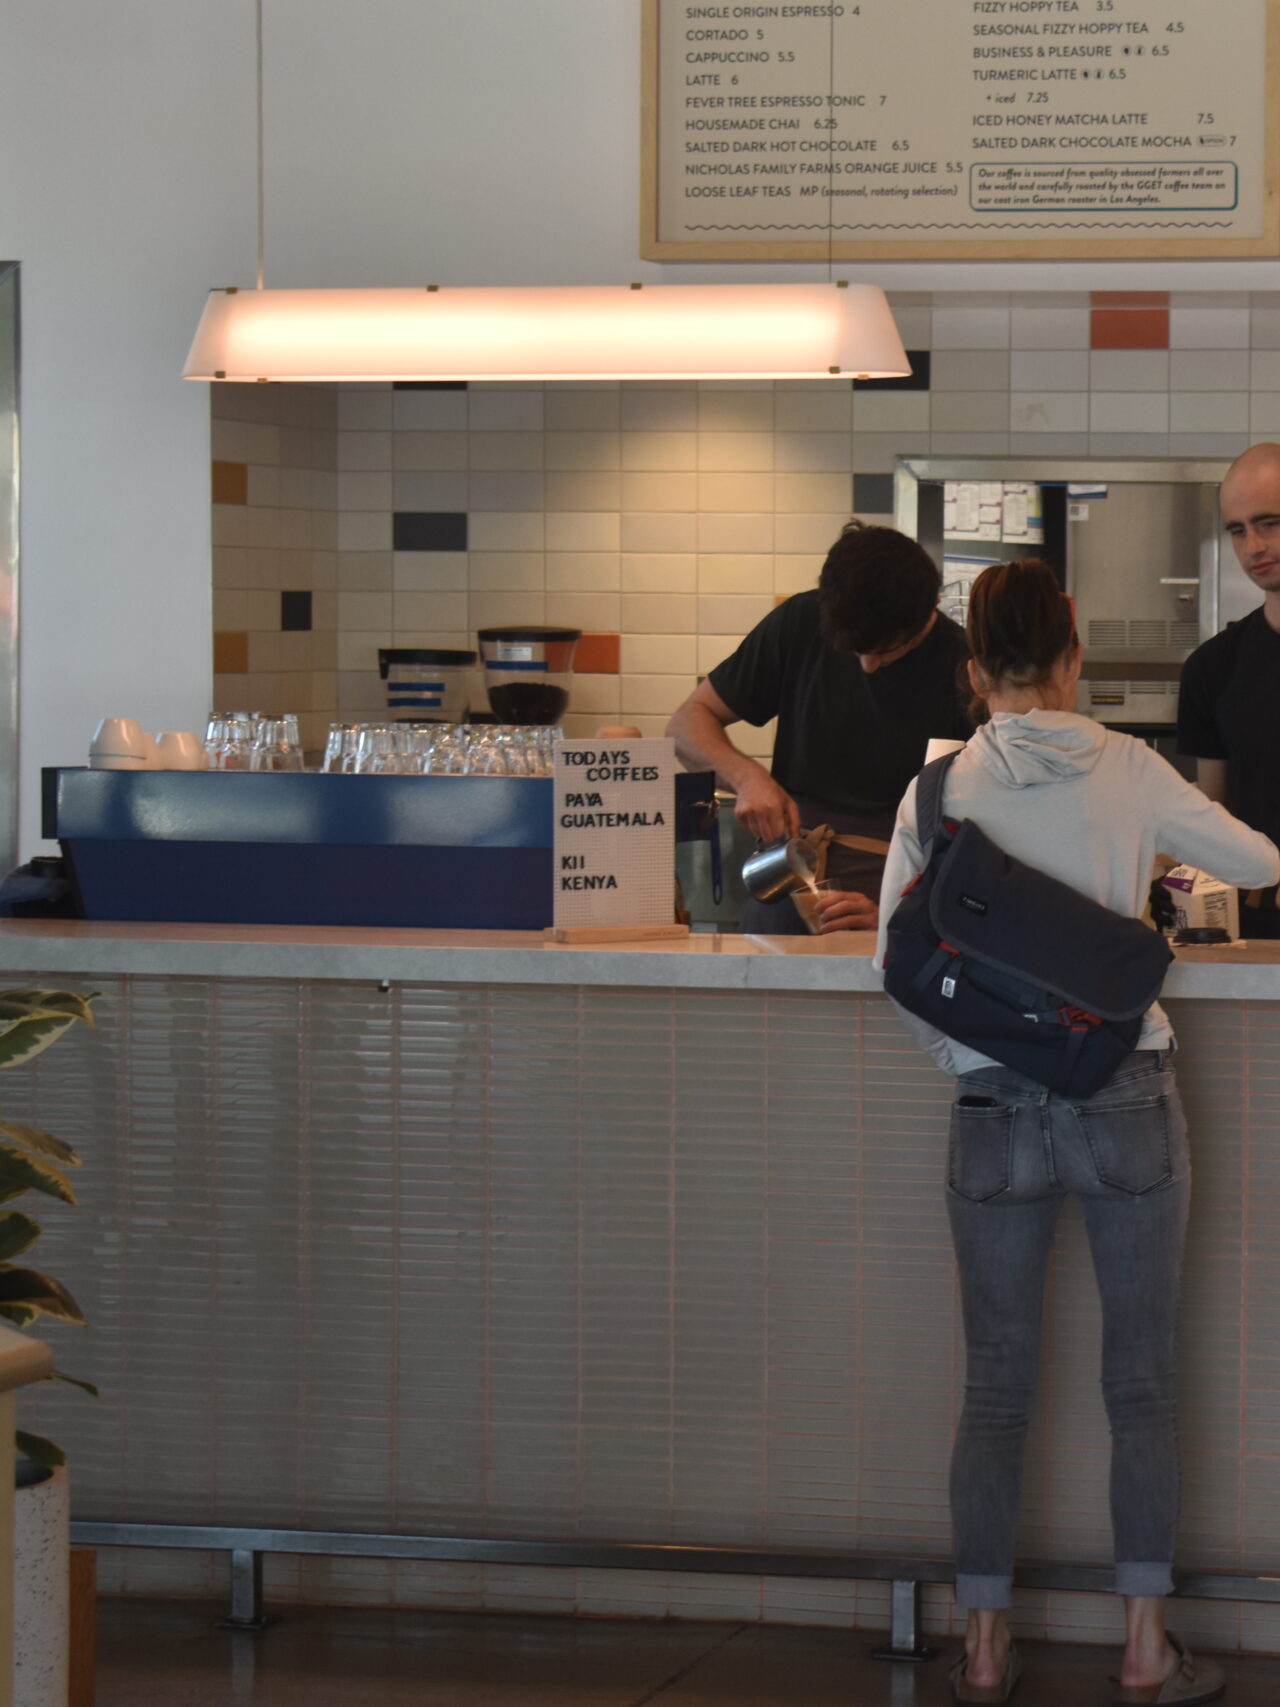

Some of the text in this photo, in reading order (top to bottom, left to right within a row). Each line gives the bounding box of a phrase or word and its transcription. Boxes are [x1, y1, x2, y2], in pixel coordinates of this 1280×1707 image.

[686, 5, 860, 19] SINGLE ORIGIN ESPRESSO 4
[973, 0, 1114, 13] FIZZY HOPPY TEA 3.5
[686, 29, 764, 41] CORTADO 5
[973, 22, 1184, 36] SEASONAL FIZZY HOPPY TEA 4.5
[686, 51, 795, 63] CAPPUCCINO 5.5
[973, 45, 1169, 58] BUSINESS & PLEASURE 6.5
[686, 74, 738, 86] LATTE 6
[972, 68, 1126, 81] TURMERIC LATTE 6.5
[686, 95, 886, 108] FEVER TREE ESPRESSO TONIC 7
[995, 92, 1049, 103] iced 7.25
[685, 118, 838, 130] HOUSEMADE CHAI 6.25
[973, 113, 1214, 126] ICED HONEY MATCHA LATTE 7.5
[685, 140, 909, 153] SALTED DARK HOT CHOCOLATE 6.5
[972, 137, 1018, 148] SALTED
[1021, 137, 1056, 148] DARK
[1059, 136, 1138, 148] CHOCOLATE
[1141, 136, 1192, 147] MOCHA
[1230, 135, 1236, 146] 7
[685, 162, 963, 175] NICHOLAS FAMILY FARMS ORANGE JUICE 5.5
[978, 168, 995, 178] Our
[997, 168, 1022, 180] coffee
[685, 186, 726, 198] LOOSE
[729, 186, 759, 197] LEAF
[761, 186, 791, 197] TEAS
[800, 185, 819, 196] MP
[870, 186, 909, 199] rotating
[1137, 180, 1189, 192] GGET coffee
[1125, 194, 1161, 206] Angeles.
[562, 751, 630, 766] TODAYS
[586, 767, 659, 781] COFFEES
[565, 793, 603, 807] PAYA
[560, 812, 665, 828] GUATEMALA
[562, 856, 584, 870] KII
[561, 875, 617, 890] KENYA
